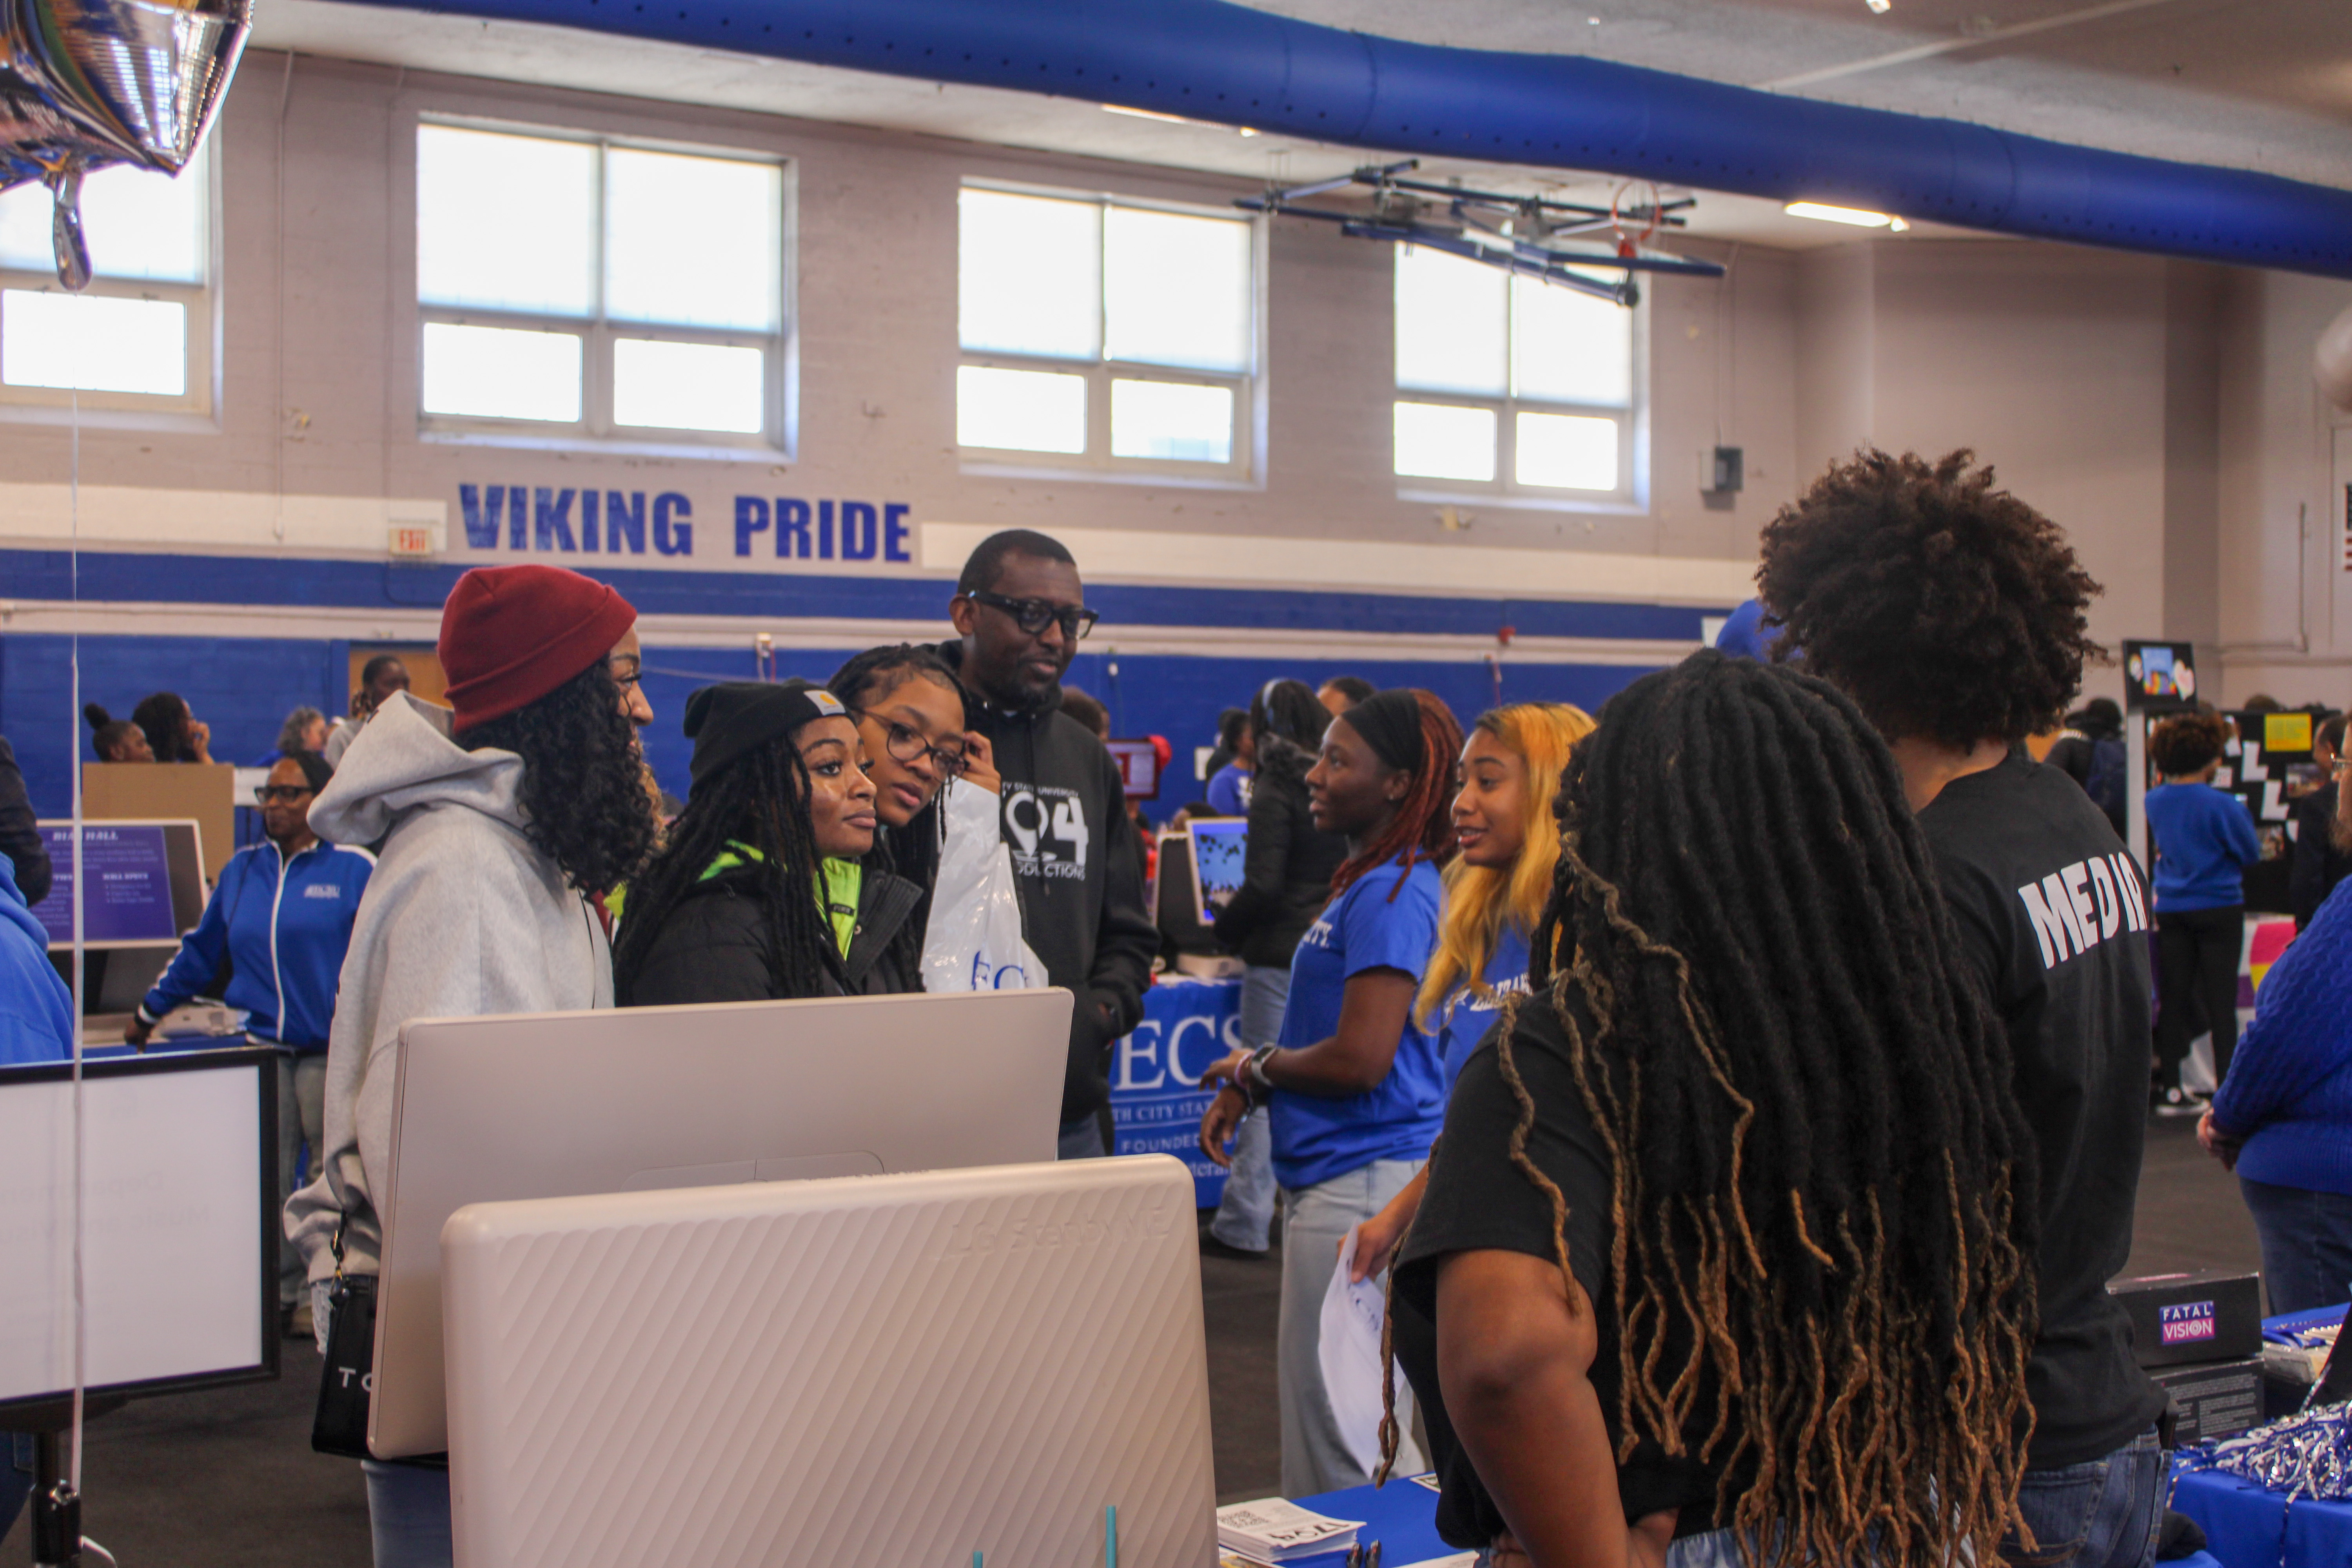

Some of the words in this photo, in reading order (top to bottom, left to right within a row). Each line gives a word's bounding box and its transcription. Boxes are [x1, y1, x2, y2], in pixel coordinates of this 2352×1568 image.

[459, 484, 693, 556] VIKING
[735, 495, 910, 563] PRIDE
[2018, 851, 2148, 969] MEDIA
[1136, 1104, 1175, 1121] CITY
[2163, 1304, 2211, 1321] FATAL
[2163, 1319, 2212, 1339] VISION
